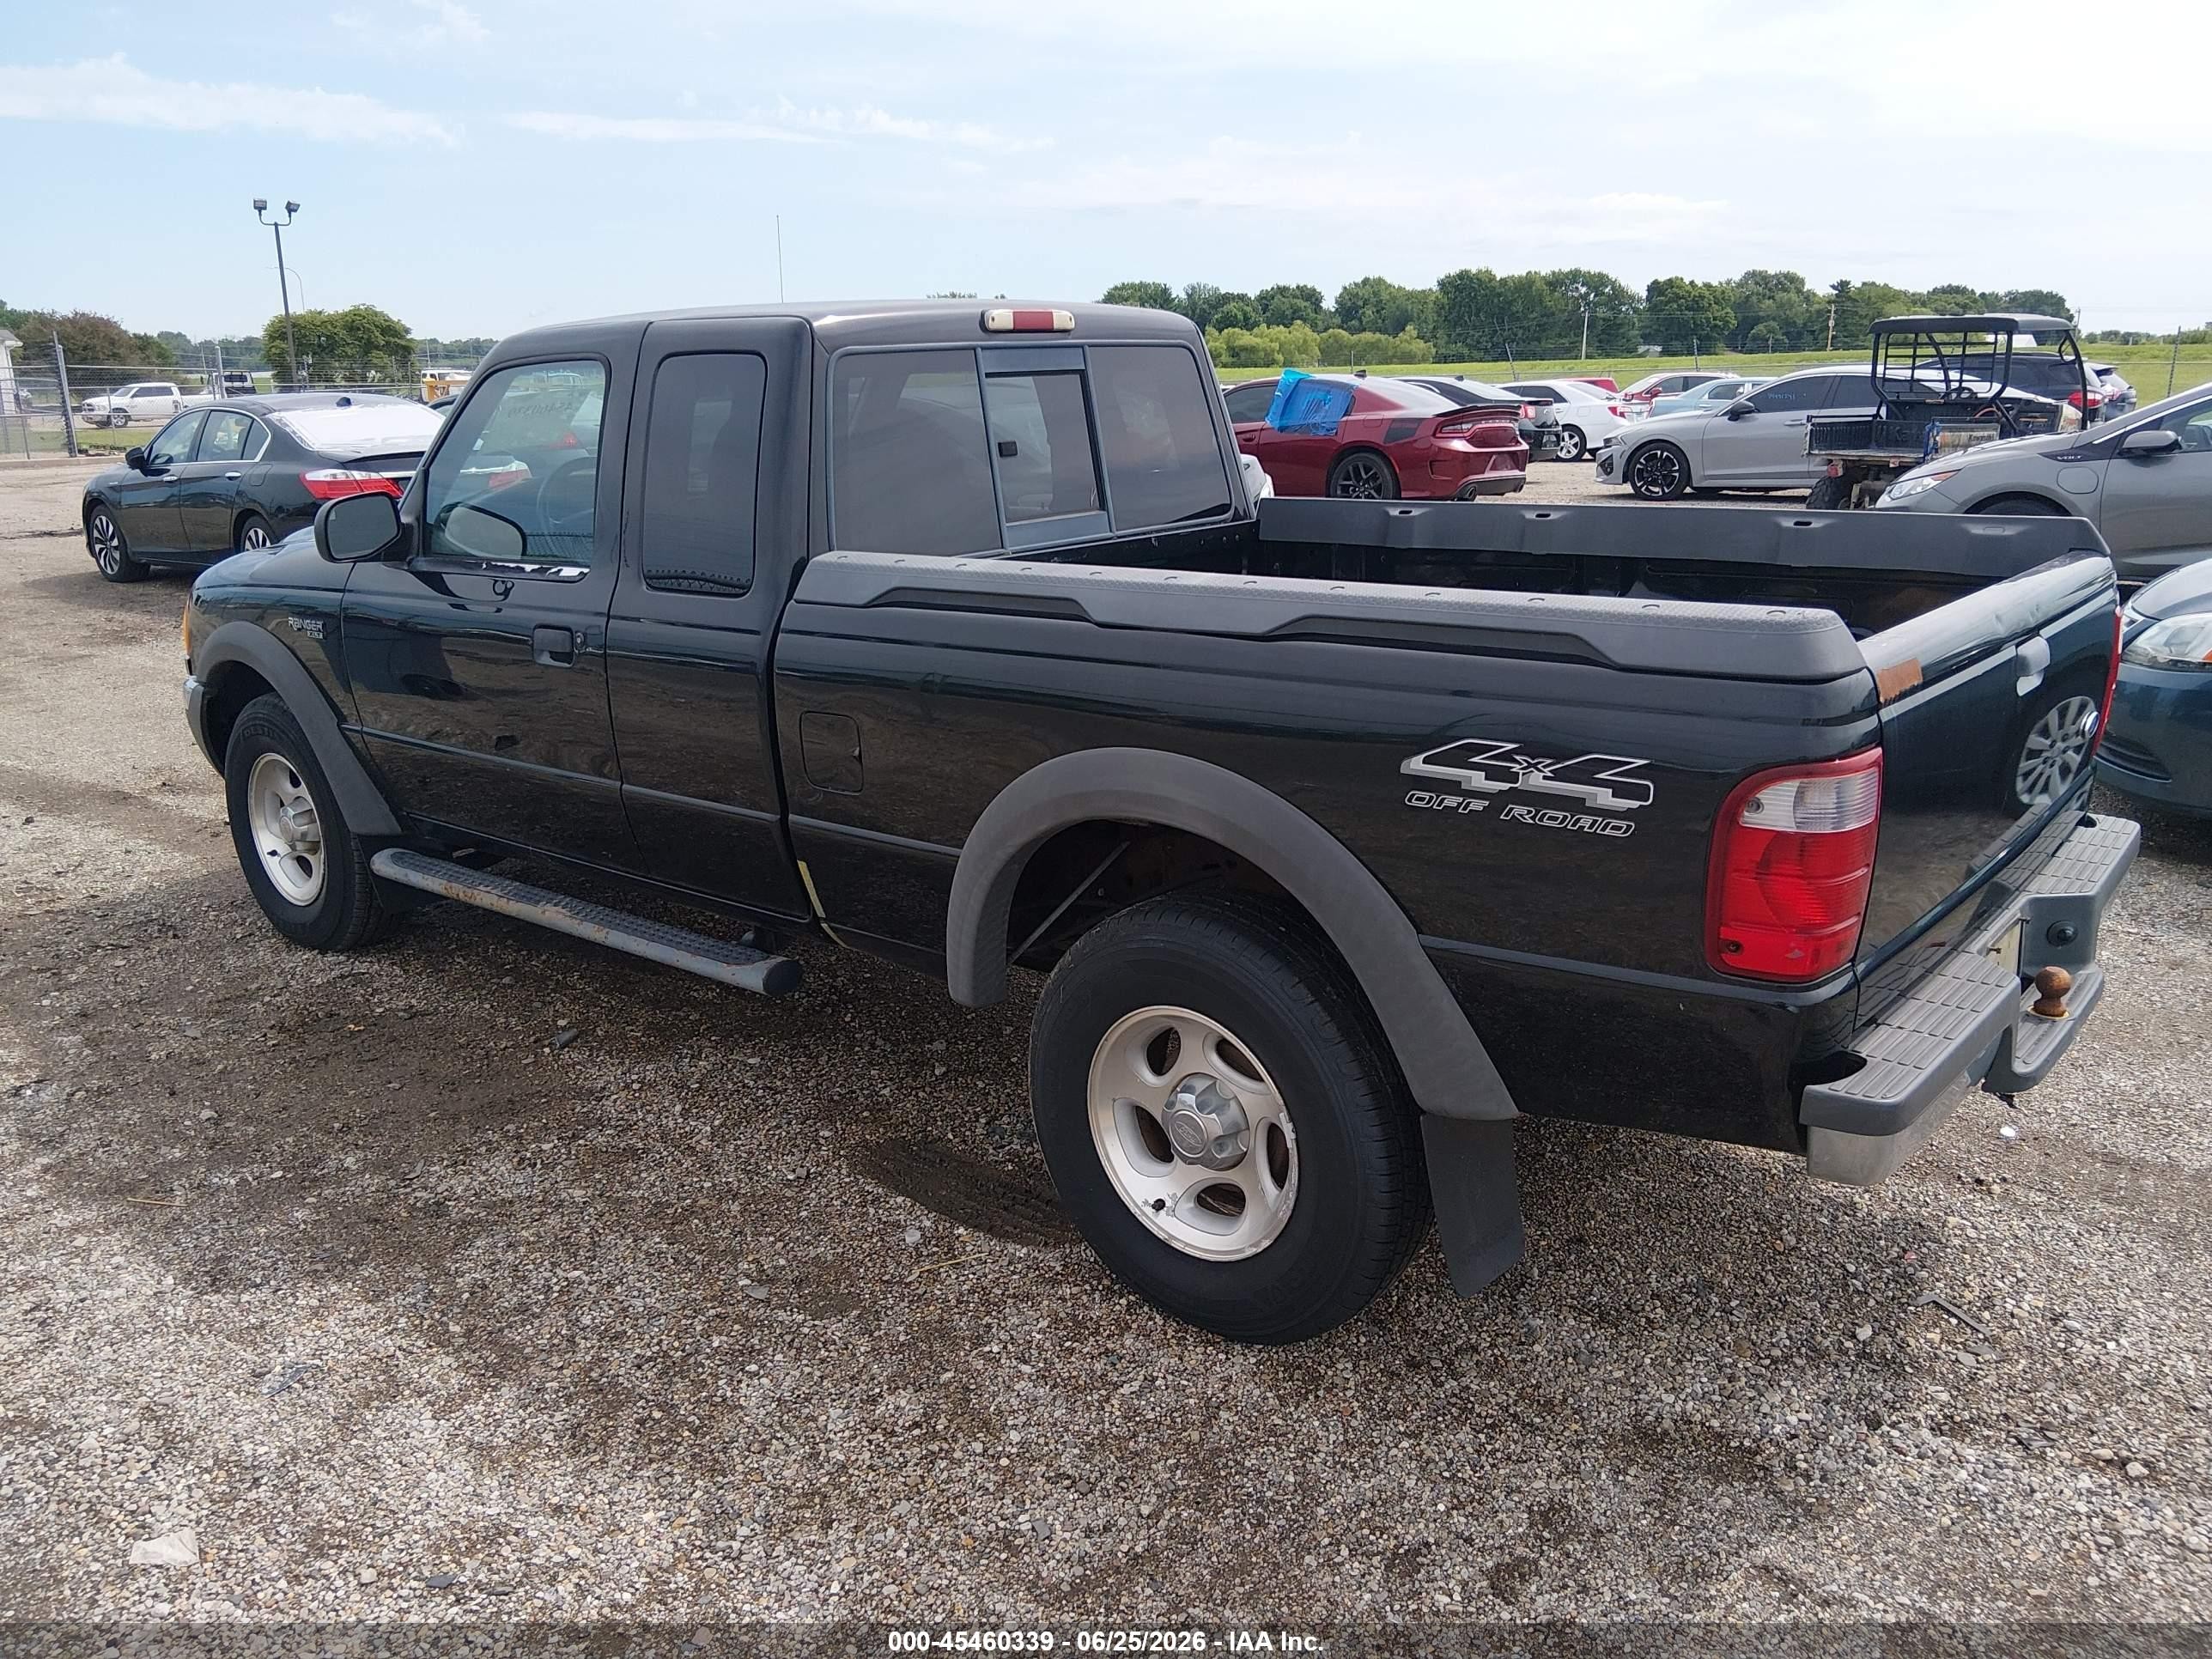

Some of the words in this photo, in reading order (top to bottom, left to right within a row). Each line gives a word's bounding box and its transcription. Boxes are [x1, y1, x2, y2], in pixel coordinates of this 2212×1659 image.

[288, 617, 324, 632] RANGER
[1405, 790, 1490, 813] OFF
[1499, 804, 1636, 837] ROAD
